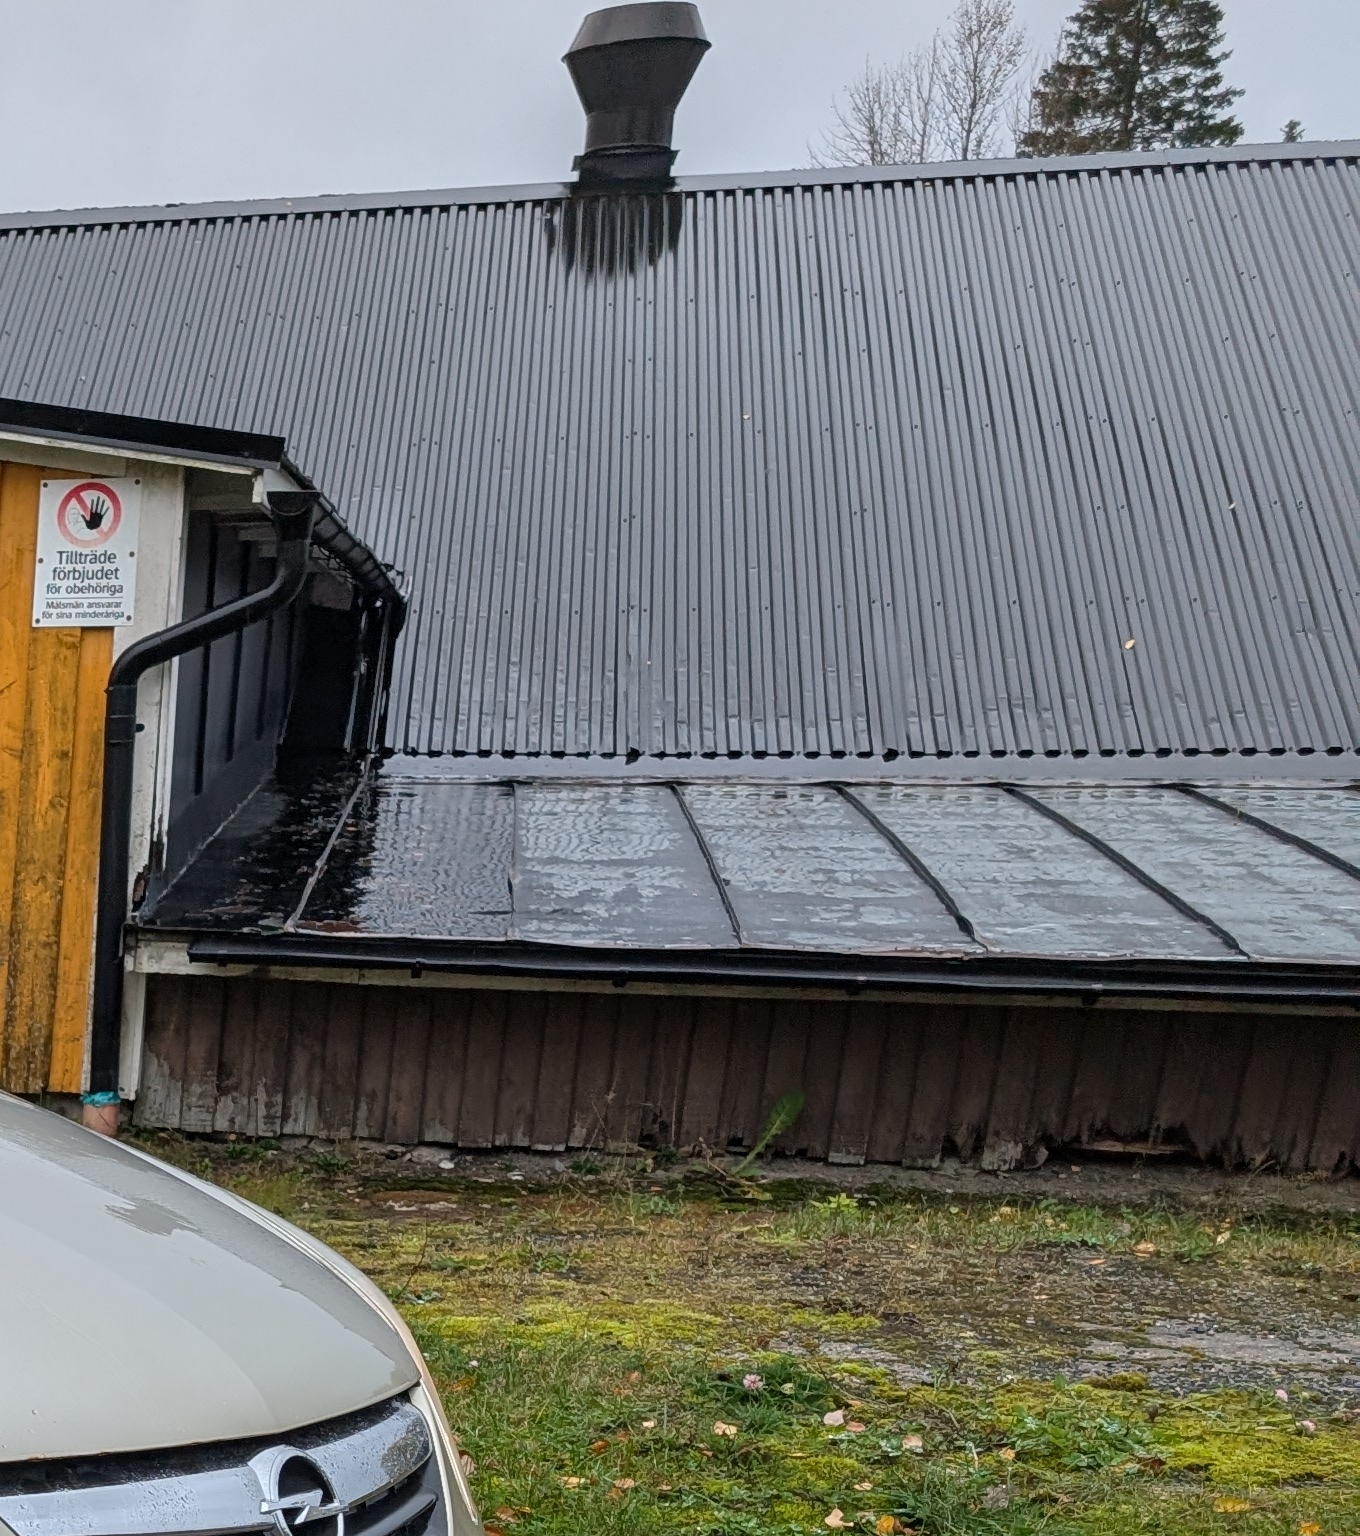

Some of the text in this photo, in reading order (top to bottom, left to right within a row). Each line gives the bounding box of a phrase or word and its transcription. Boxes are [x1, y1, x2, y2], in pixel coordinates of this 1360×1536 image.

[56, 549, 117, 565] Tillträde
[52, 566, 120, 583] förbjudet
[46, 582, 124, 596] för obehöriga
[87, 601, 122, 609] ansvarar
[42, 610, 53, 619] för
[55, 611, 72, 619] sina
